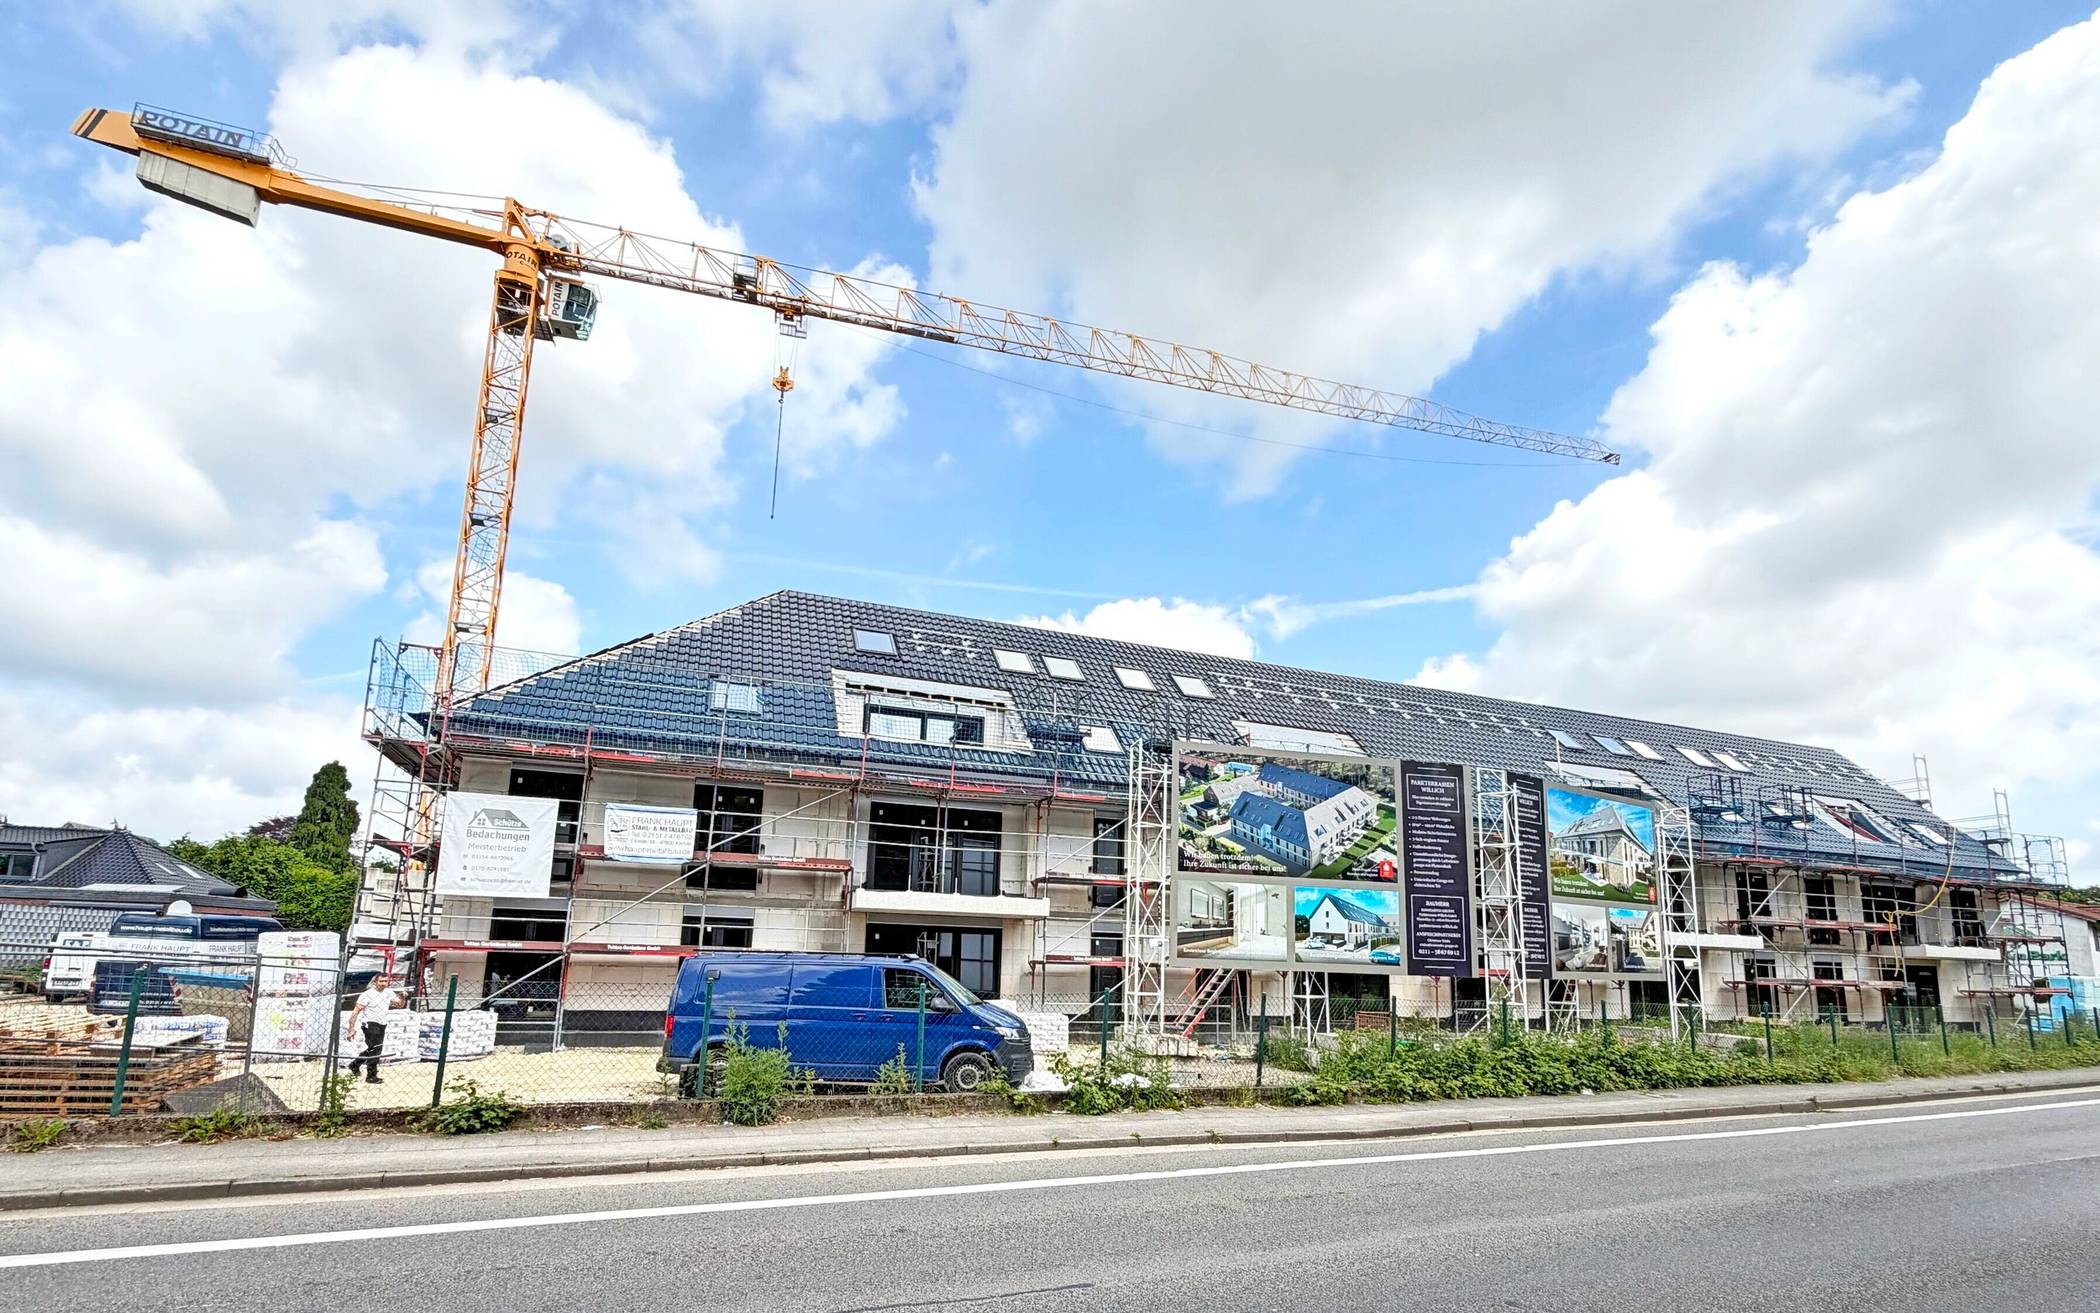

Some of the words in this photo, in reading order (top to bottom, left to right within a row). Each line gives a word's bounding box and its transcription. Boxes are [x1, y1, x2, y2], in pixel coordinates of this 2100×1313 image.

[141, 110, 244, 148] POTAIN
[506, 251, 538, 269] OTAIN
[552, 281, 563, 316] POTAIN
[632, 816, 663, 825] FRANK
[665, 818, 693, 827] HAUPT
[466, 829, 530, 842] Bedachungen
[468, 843, 527, 852] Meisterbetrieb
[1199, 860, 1227, 869] Zukunft
[160, 944, 192, 953] HAUPT
[209, 944, 227, 952] FRANK
